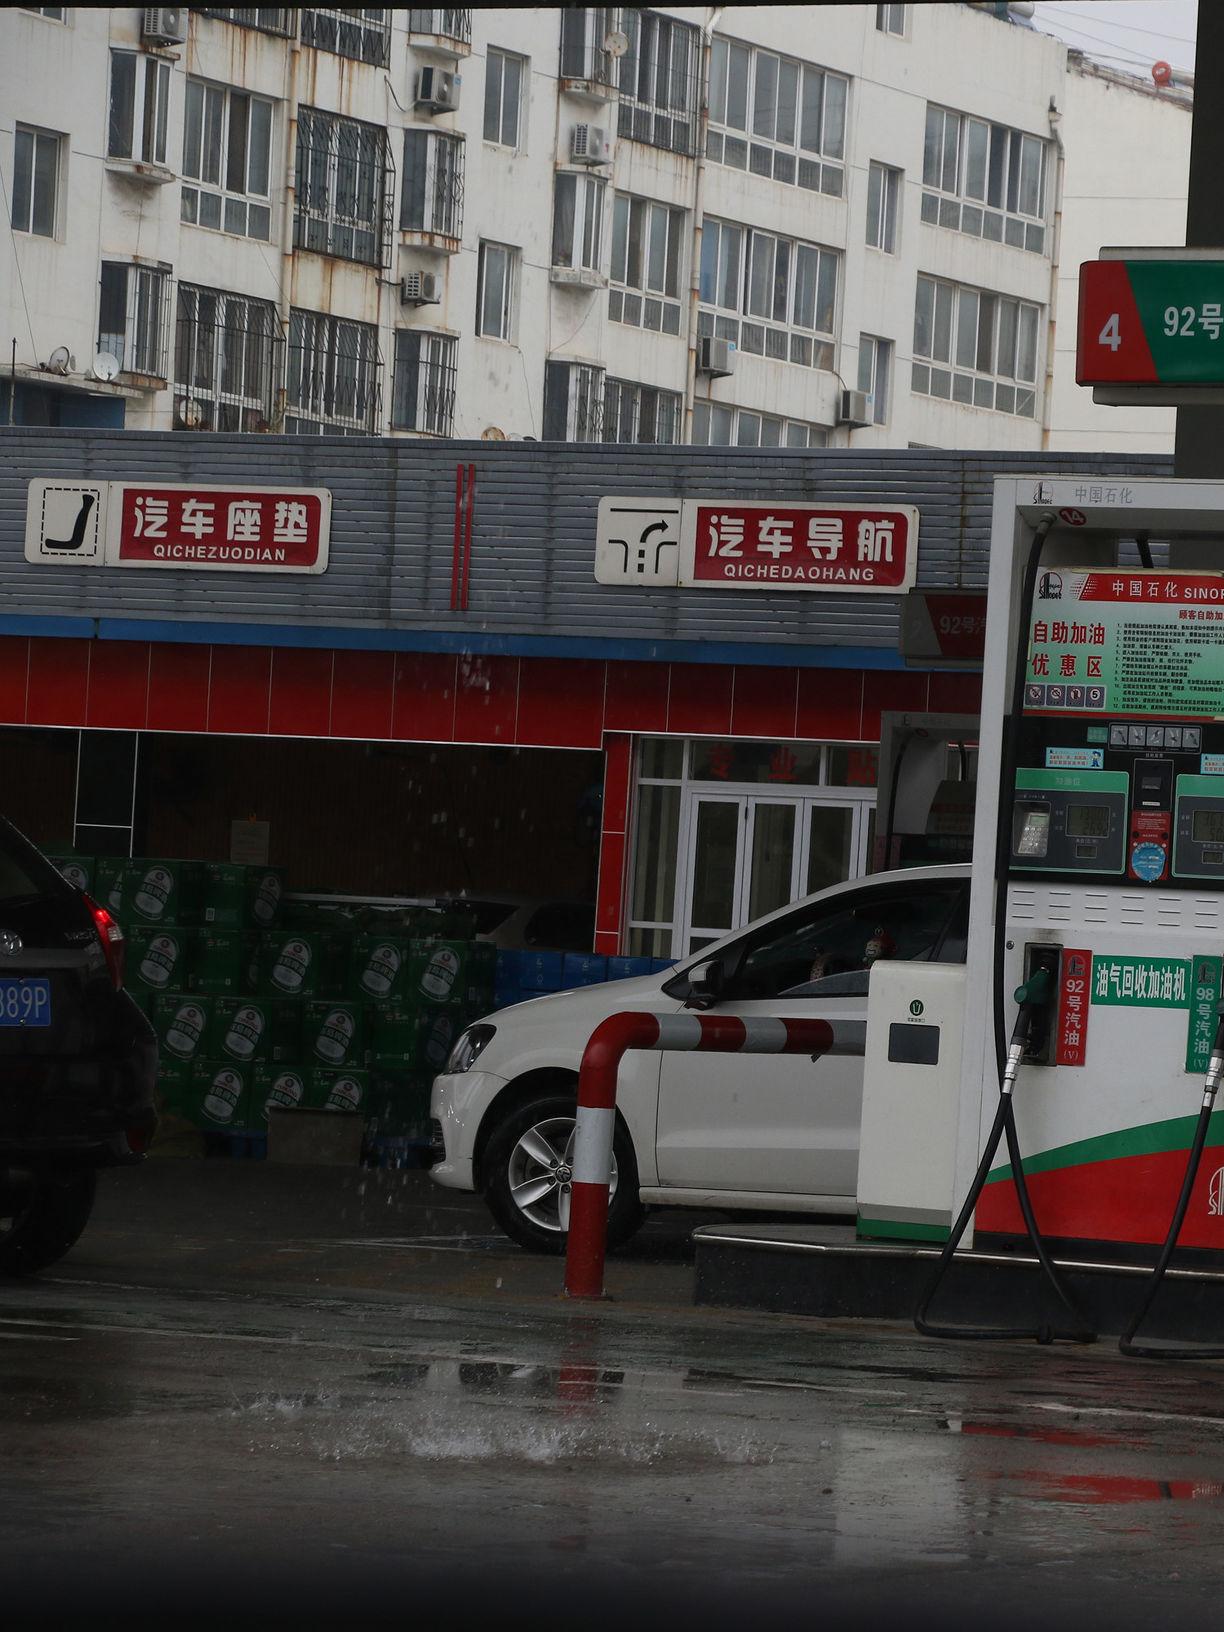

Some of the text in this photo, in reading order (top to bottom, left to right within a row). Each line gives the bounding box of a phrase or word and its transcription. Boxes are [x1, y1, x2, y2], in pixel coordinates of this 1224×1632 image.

[1098, 313, 1122, 352] 4
[1075, 485, 1133, 504] 中国石化
[133, 496, 308, 544] 汽车座垫
[1061, 509, 1086, 525] 14
[708, 515, 895, 562] 汽车导航
[153, 545, 286, 561] QICHEZUODIAN
[724, 563, 874, 581] QICHEDAOHANG
[1112, 580, 1178, 598] 中国石化
[1033, 621, 1106, 645] 自助加油
[1031, 654, 1103, 678] 优惠区
[1096, 963, 1187, 1001] 油气回收加油机
[0, 986, 47, 1019] 89P
